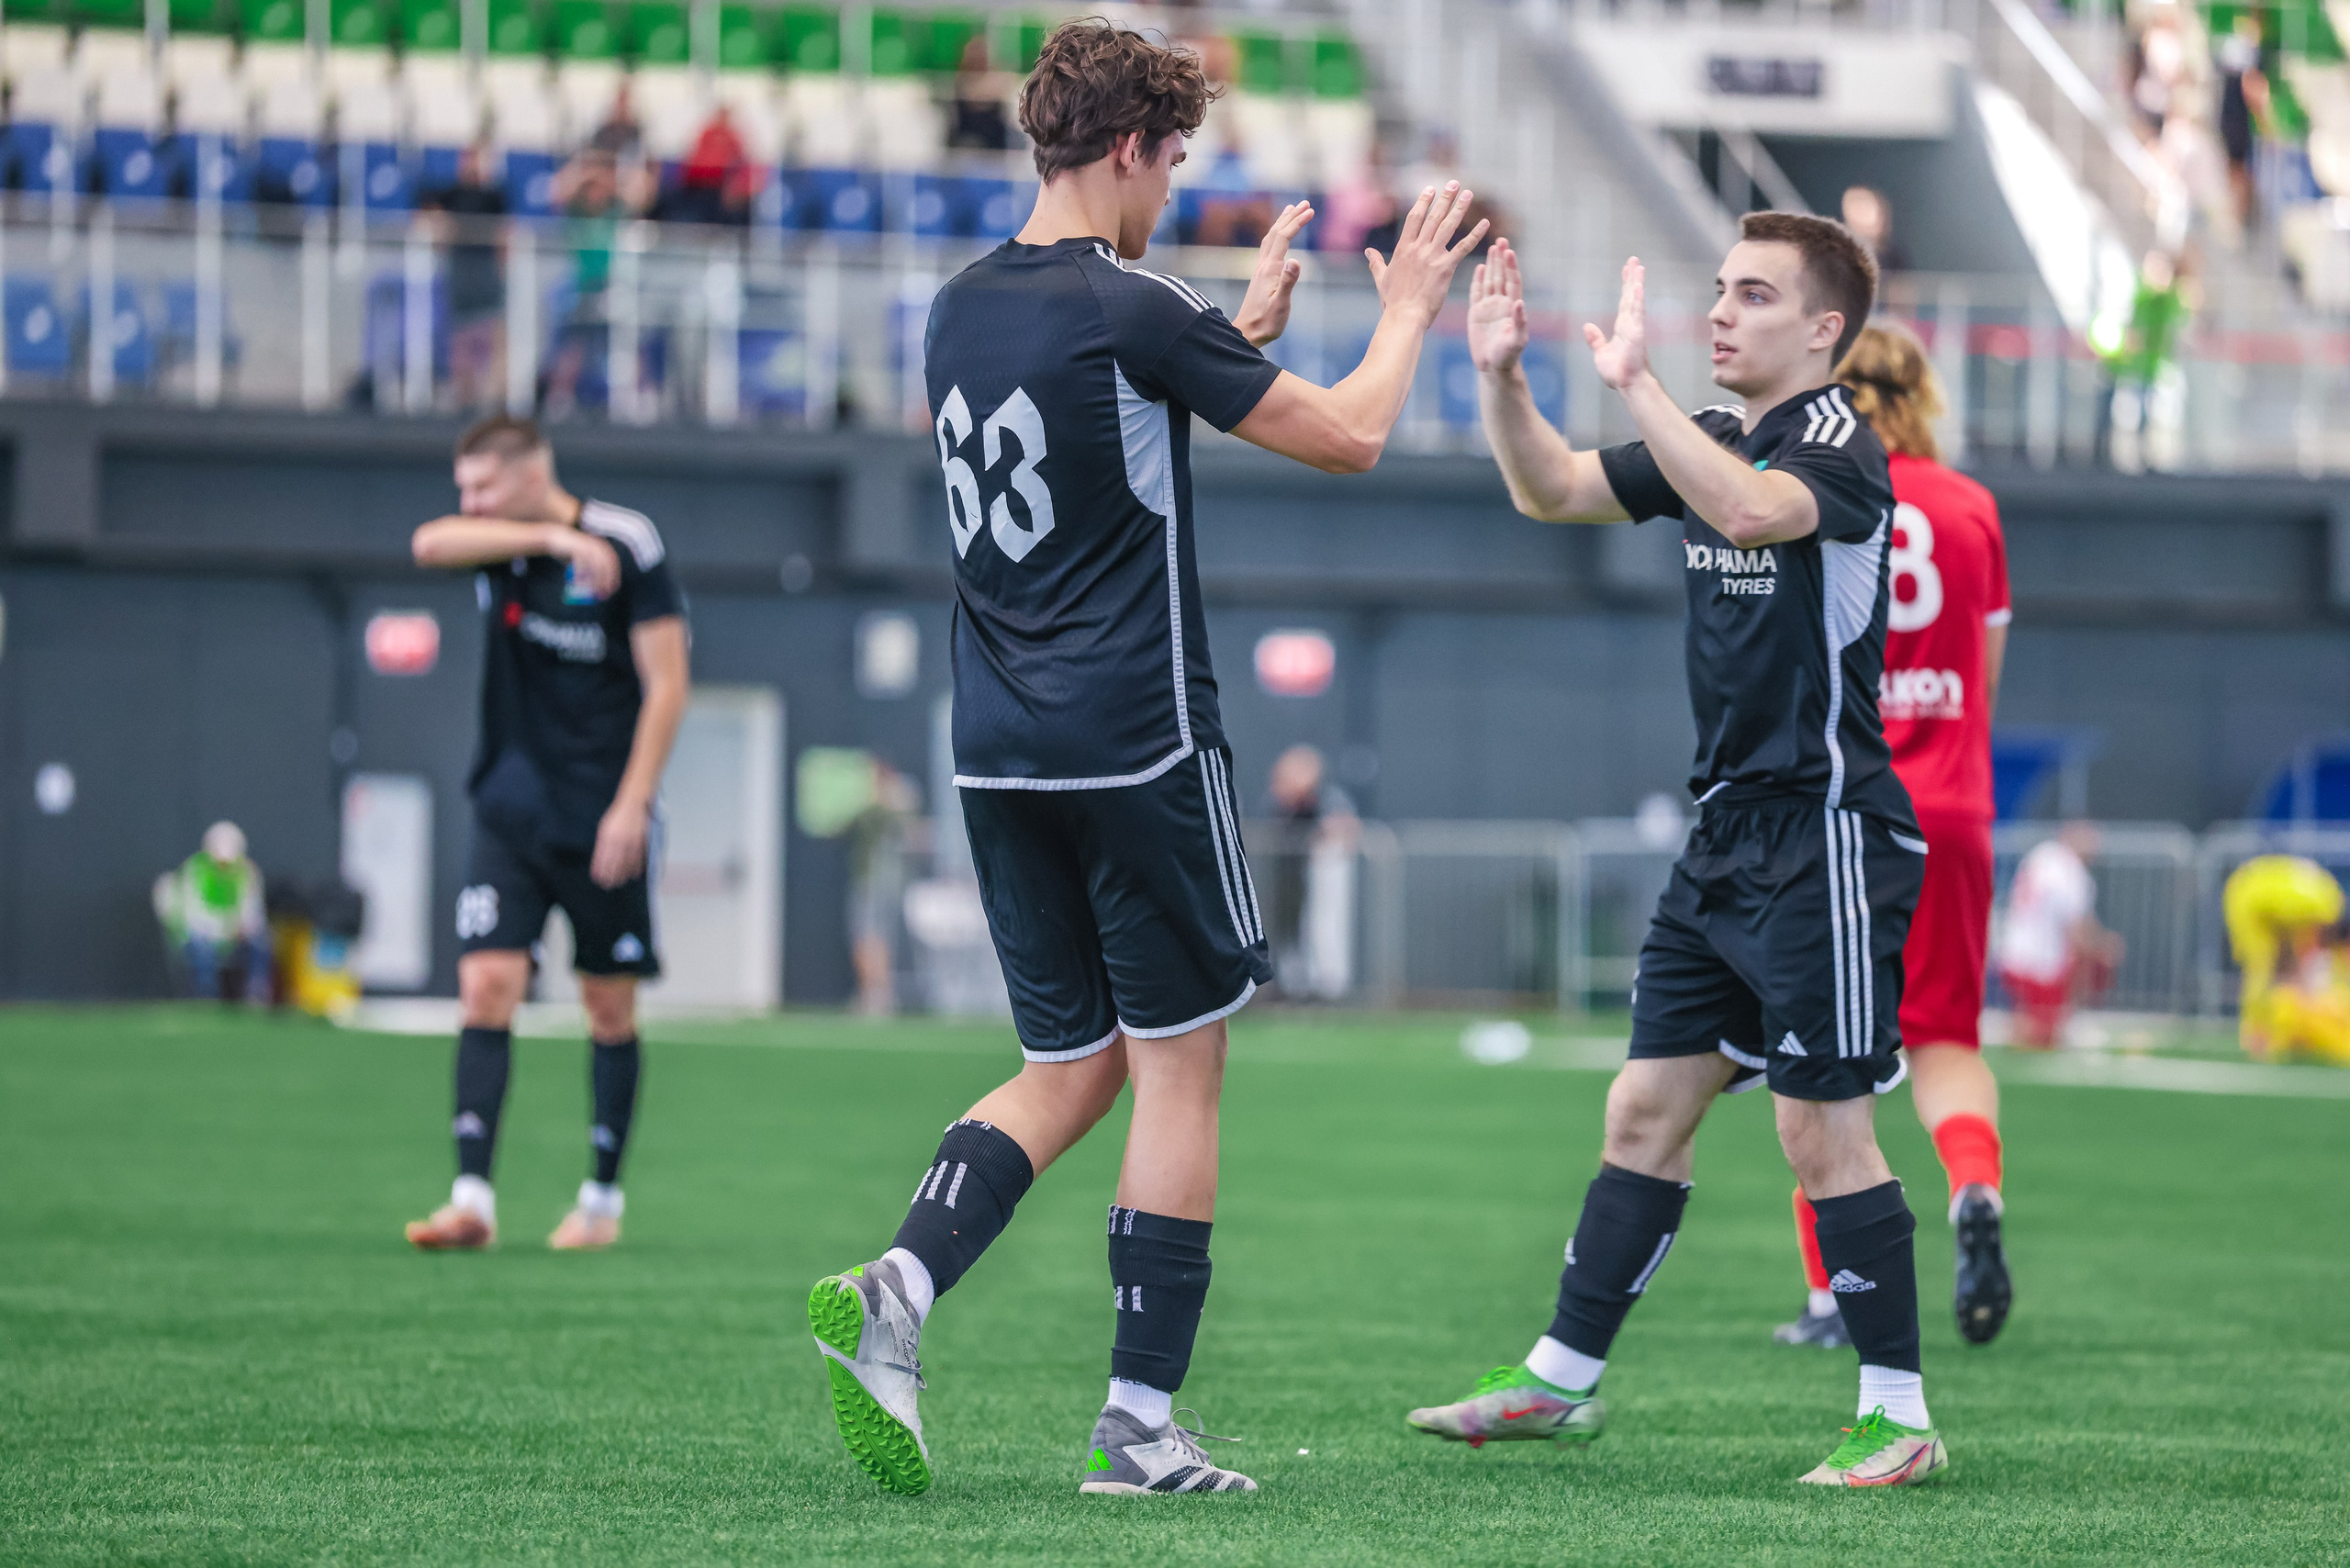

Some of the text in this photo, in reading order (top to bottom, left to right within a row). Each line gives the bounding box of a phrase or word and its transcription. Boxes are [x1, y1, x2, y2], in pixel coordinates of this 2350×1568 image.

[936, 384, 1055, 564] 63
[1722, 577, 1775, 595] TYRES
[1888, 501, 1943, 633] 8
